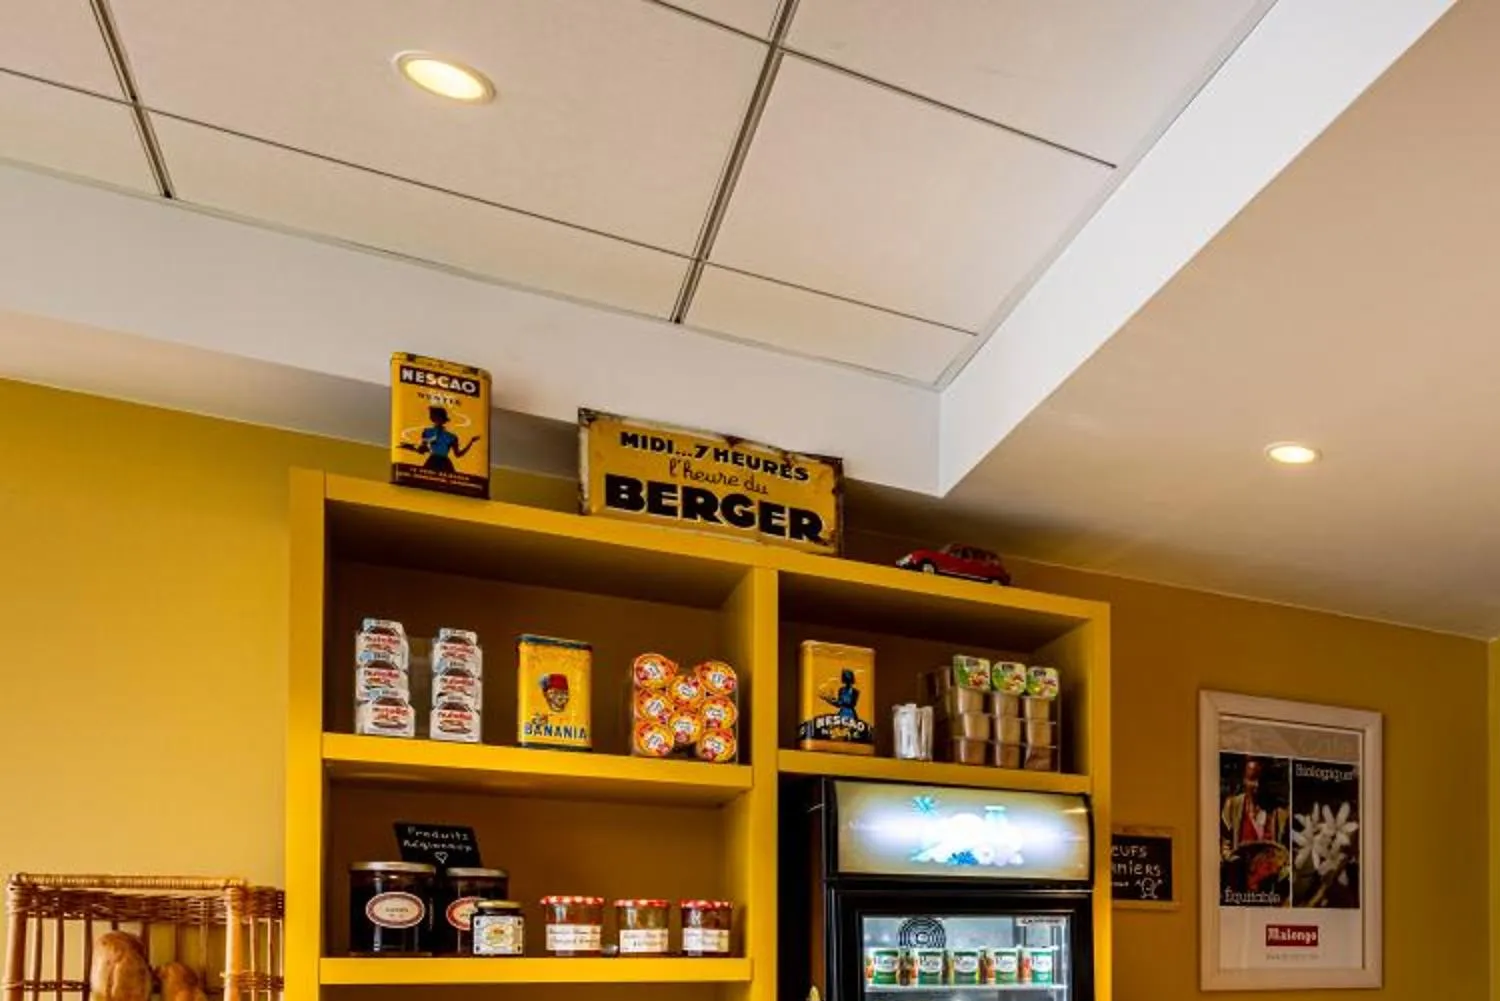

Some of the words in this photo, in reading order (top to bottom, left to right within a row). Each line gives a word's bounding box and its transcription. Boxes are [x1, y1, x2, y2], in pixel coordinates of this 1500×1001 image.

[402, 368, 477, 393] NESCAO
[669, 458, 740, 486] l'heure
[743, 478, 769, 496] du
[713, 448, 809, 481] HEURES
[605, 473, 829, 547] BERGER
[524, 722, 588, 739] BANANIA
[1111, 846, 1148, 858] EUFS
[1266, 928, 1317, 945] Malongo
